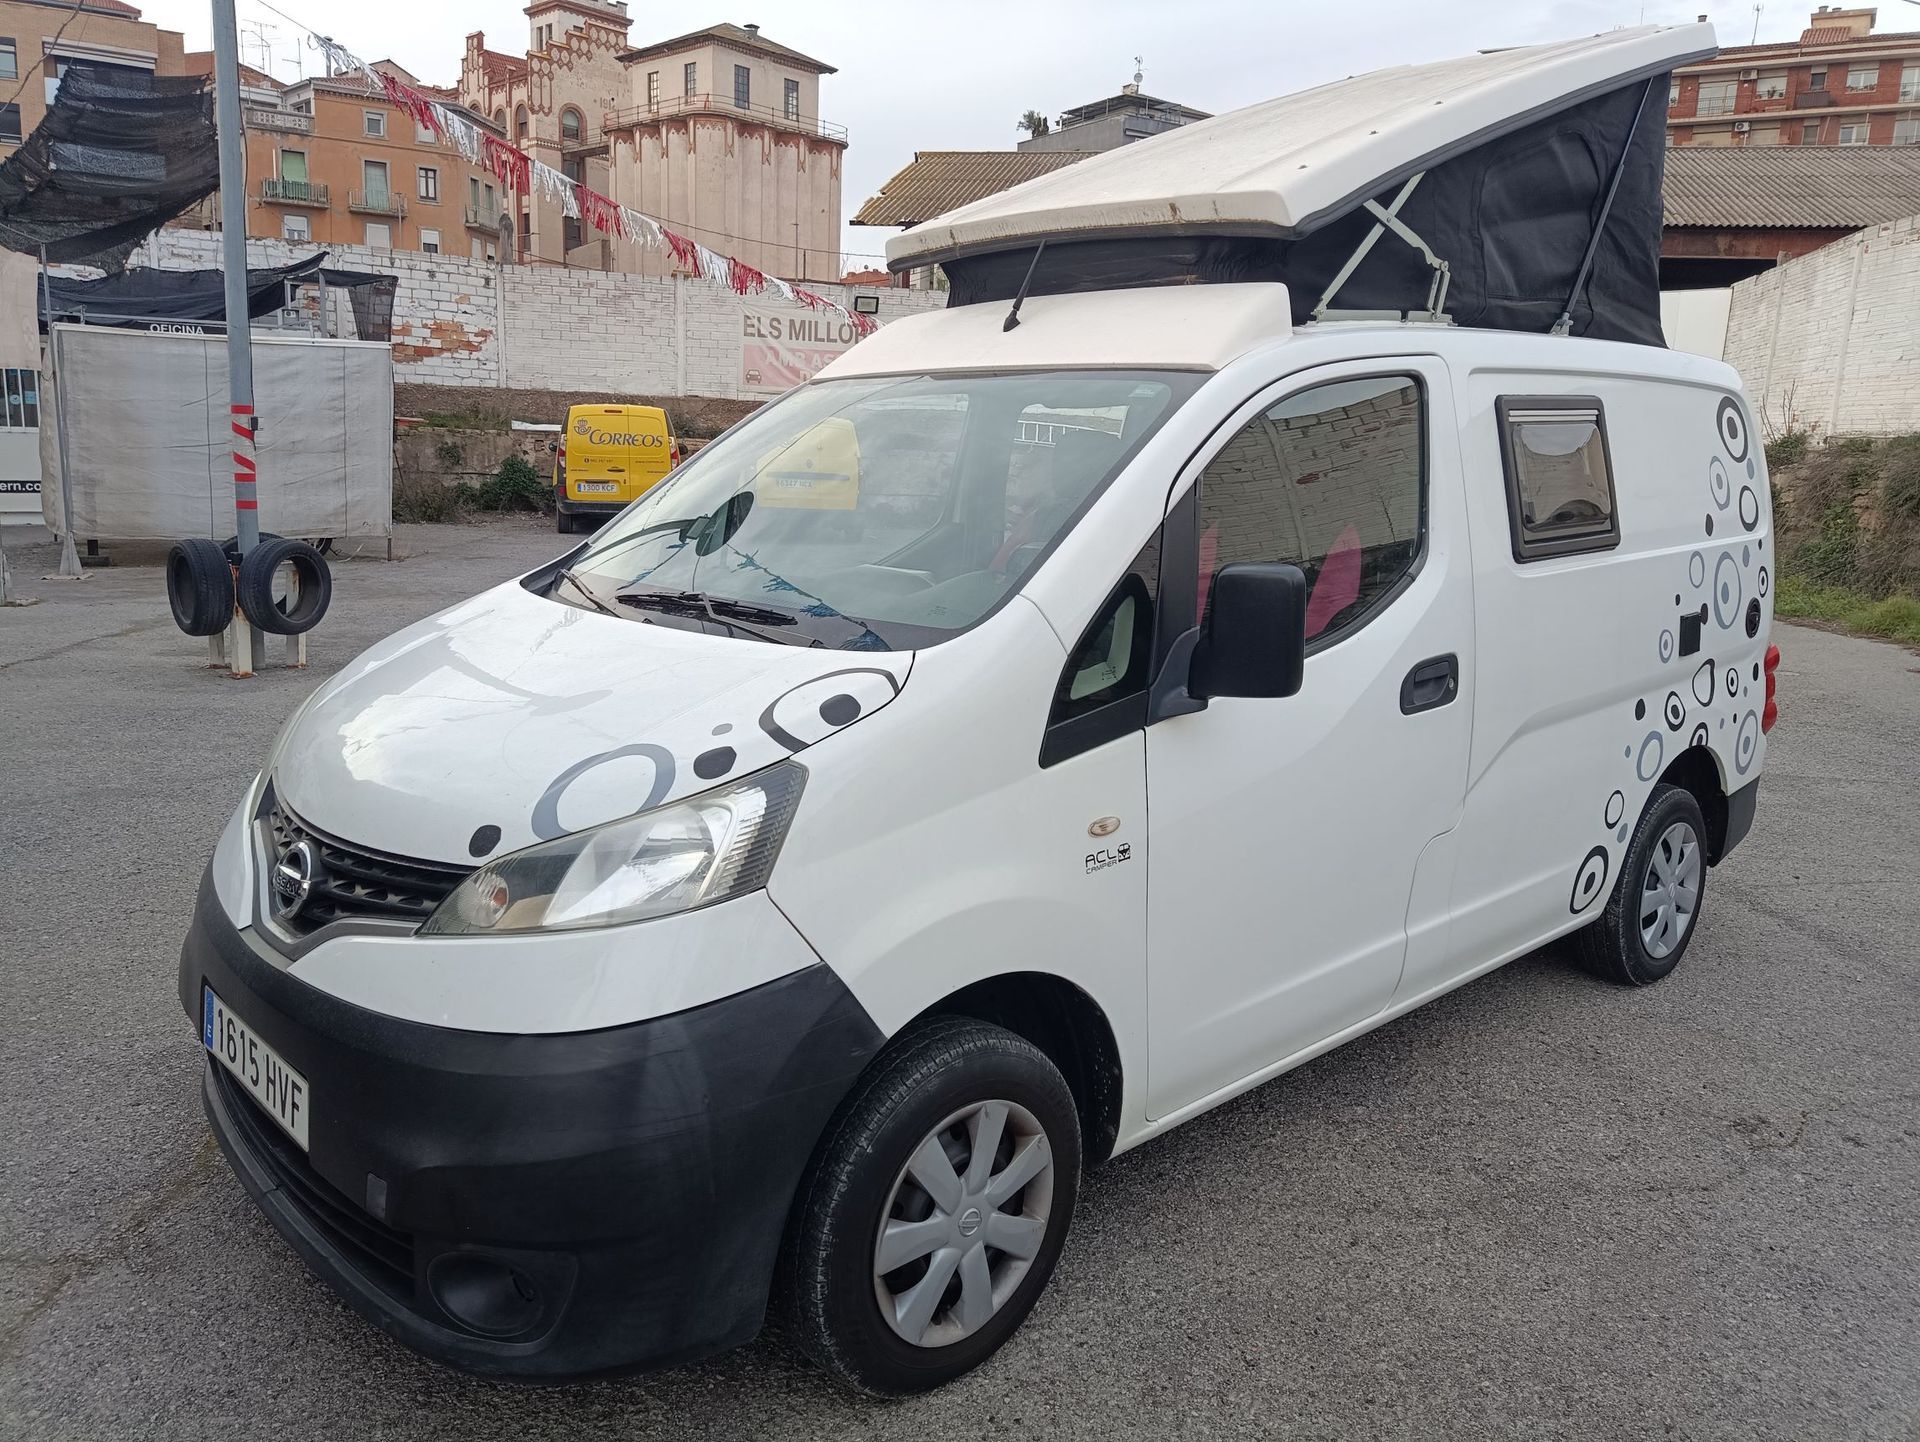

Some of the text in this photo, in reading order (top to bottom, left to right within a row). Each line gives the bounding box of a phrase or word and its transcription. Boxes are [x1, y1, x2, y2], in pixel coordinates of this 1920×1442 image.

[150, 324, 204, 335] OFICINA
[743, 315, 782, 339] ELS
[589, 429, 663, 448] CORREOS
[582, 484, 616, 492] 1300 KCF
[1085, 860, 1118, 875] CAMPER
[218, 1008, 302, 1129] 1615 HVF
